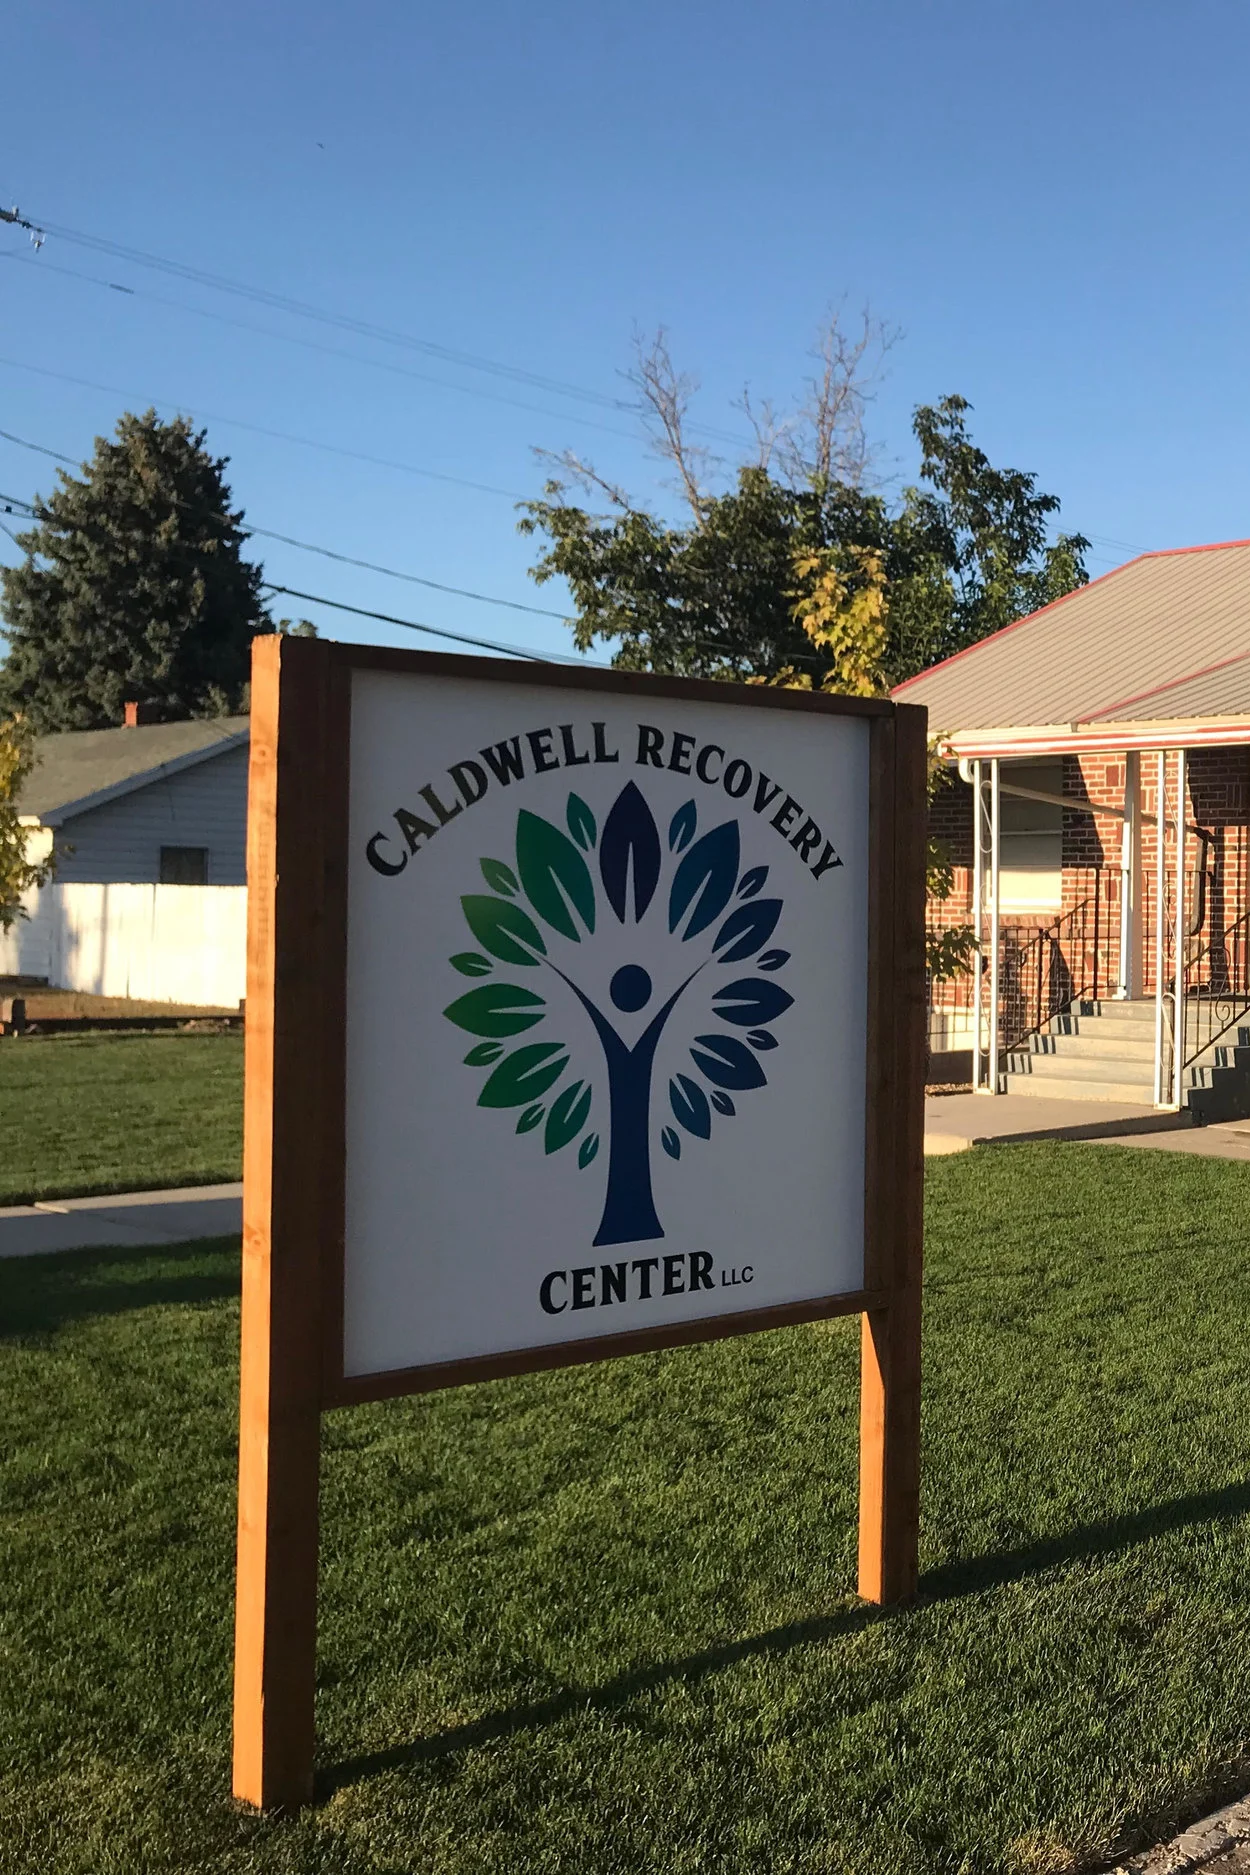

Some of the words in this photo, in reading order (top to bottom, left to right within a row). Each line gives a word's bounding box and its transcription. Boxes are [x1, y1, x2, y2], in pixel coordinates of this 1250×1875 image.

[365, 722, 619, 877] CALDWELL
[635, 723, 844, 881] RECOVERY
[539, 1250, 716, 1315] CENTER
[721, 1265, 754, 1287] LLC
